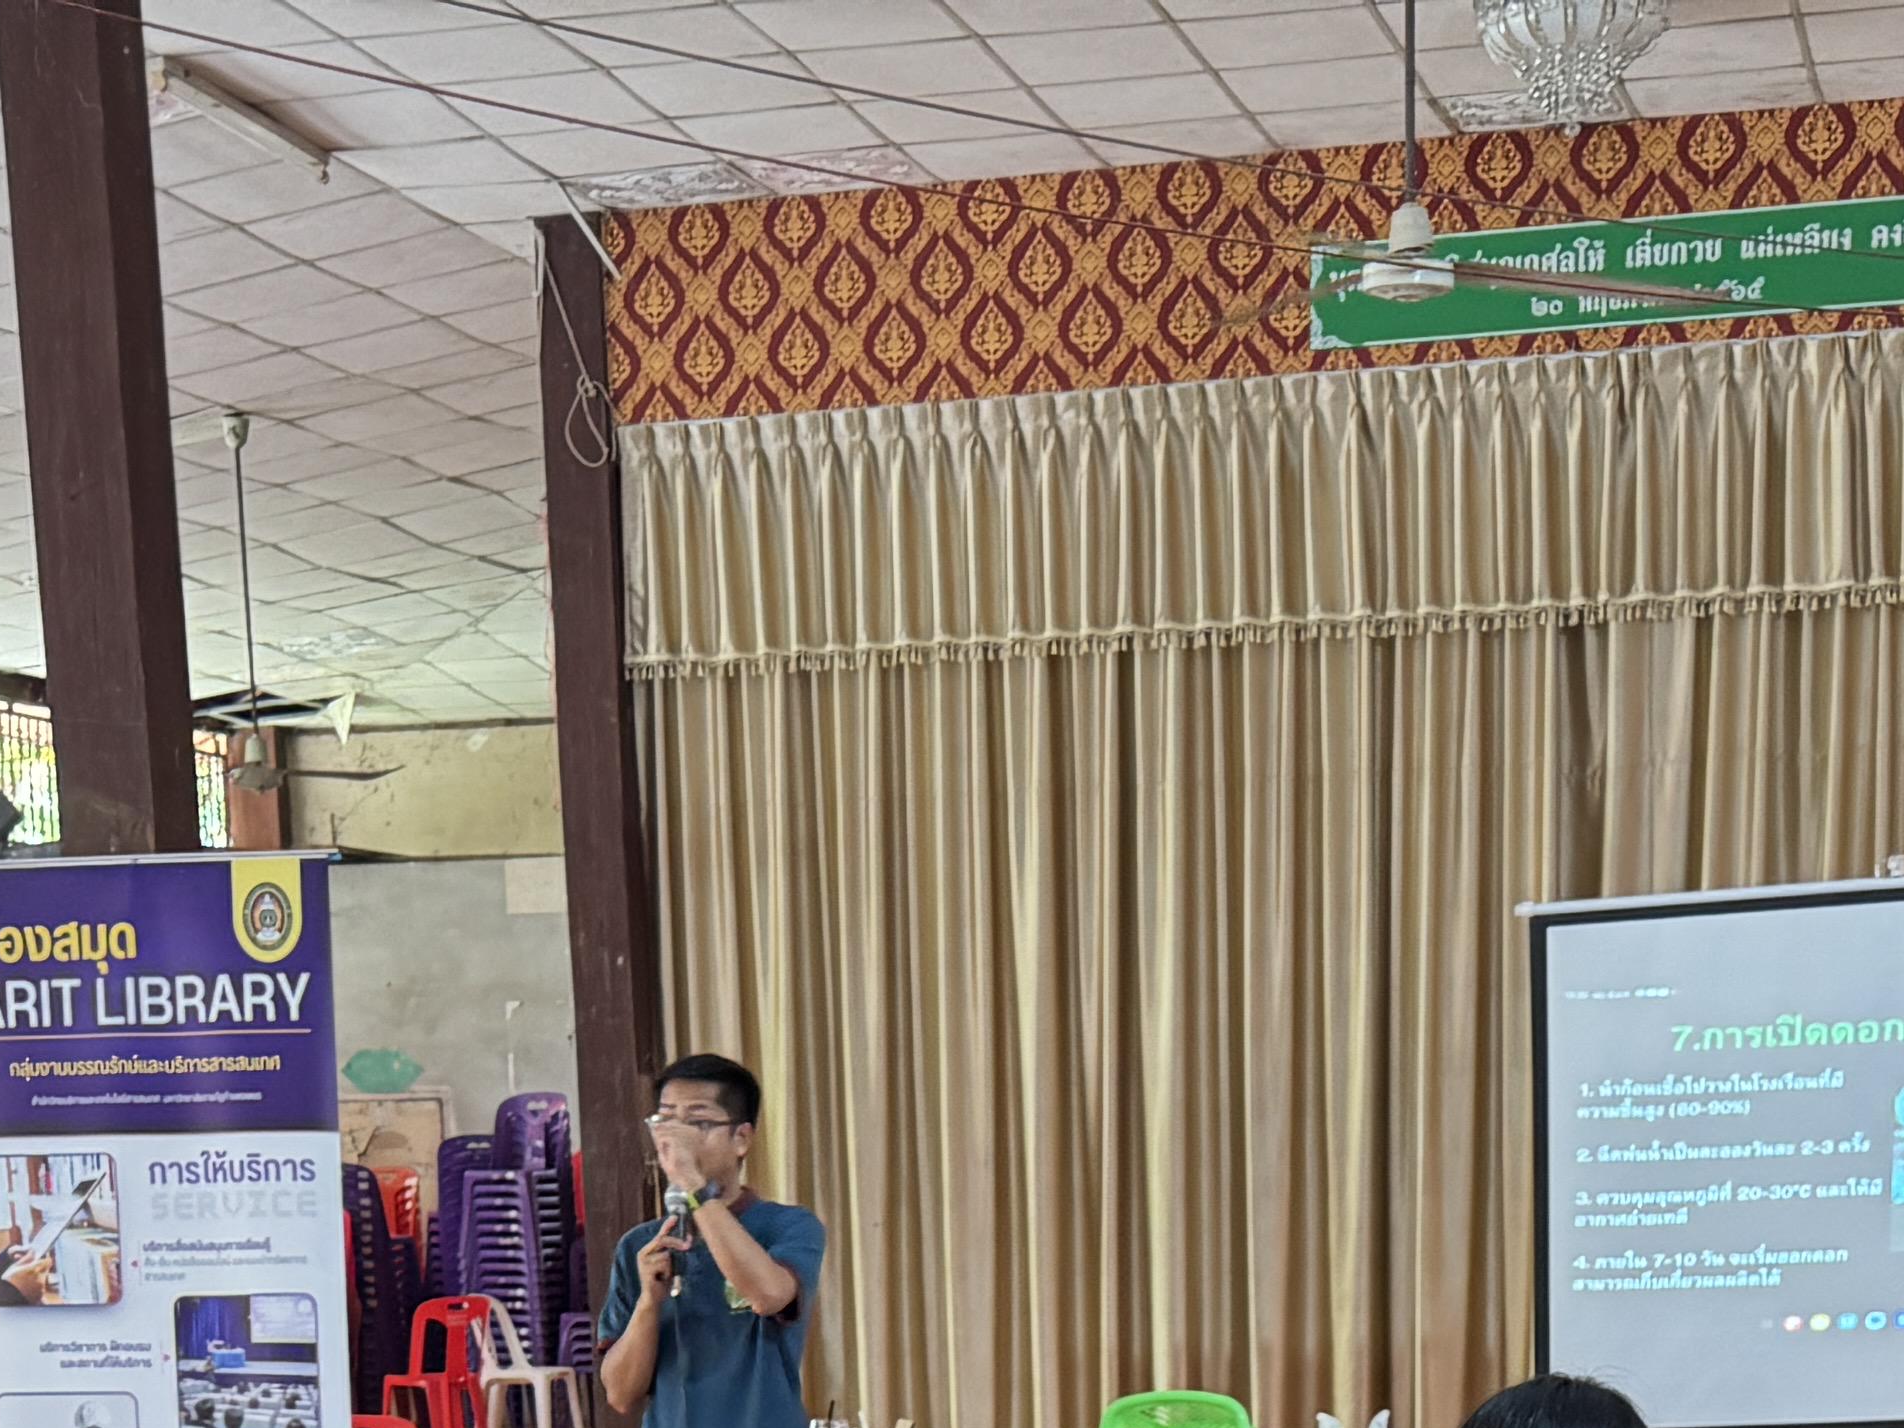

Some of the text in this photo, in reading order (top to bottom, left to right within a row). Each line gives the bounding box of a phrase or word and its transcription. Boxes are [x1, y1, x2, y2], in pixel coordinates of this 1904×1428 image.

[96, 972, 311, 1027] LIBRARY
[149, 1150, 316, 1185] การให้บริการ
